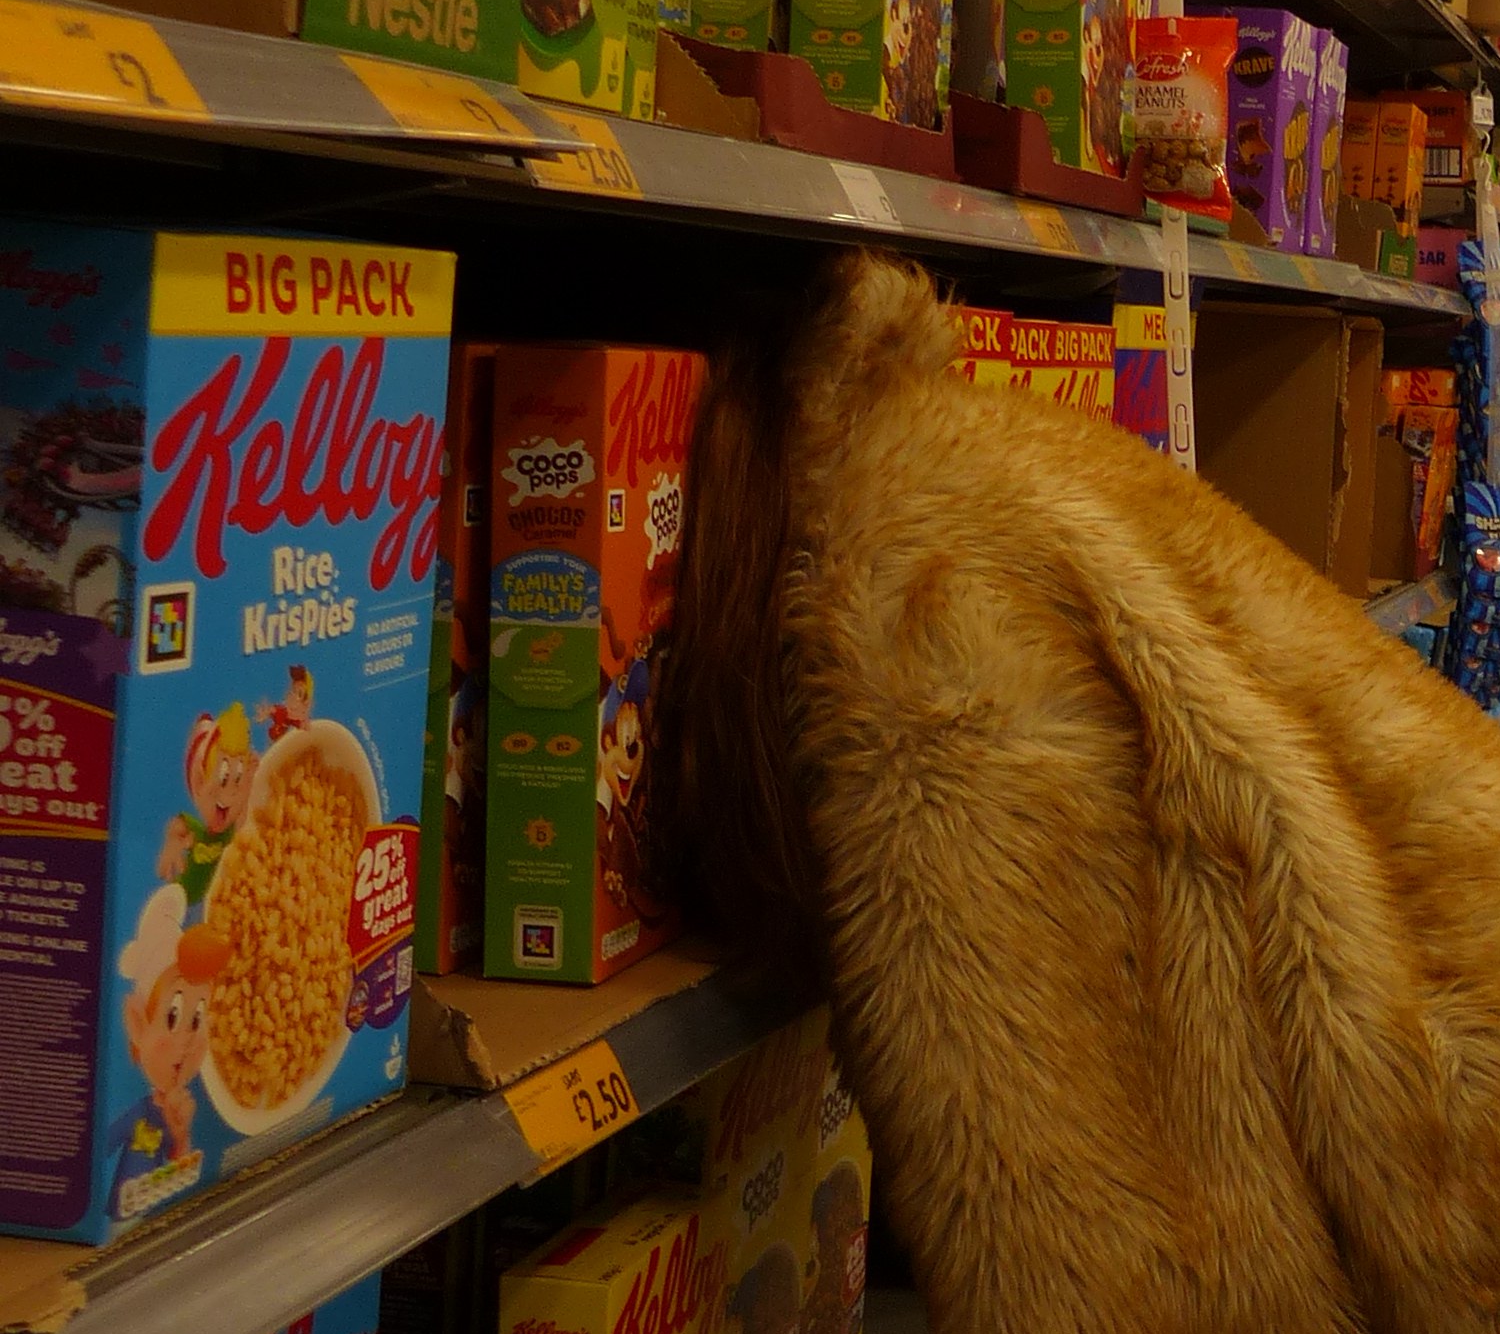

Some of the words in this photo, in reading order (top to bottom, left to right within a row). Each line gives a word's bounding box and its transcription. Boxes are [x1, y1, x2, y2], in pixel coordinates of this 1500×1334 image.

[1233, 55, 1275, 76] KRAVE
[1136, 98, 1186, 109] EANUTS
[1138, 85, 1185, 99] ARAMEL
[225, 250, 298, 316] BIG
[310, 256, 414, 319] PACK
[1055, 329, 1079, 362] BIG
[1080, 330, 1112, 363] PACK
[528, 468, 580, 493] pops
[271, 545, 334, 598] Rice
[501, 571, 586, 593] FAMILY'S
[506, 591, 586, 615] HEALTH
[243, 592, 358, 656] Krispies
[14, 733, 68, 759] off
[354, 830, 406, 903] 25%
[362, 877, 409, 932] great
[572, 1071, 631, 1133] £2.50
